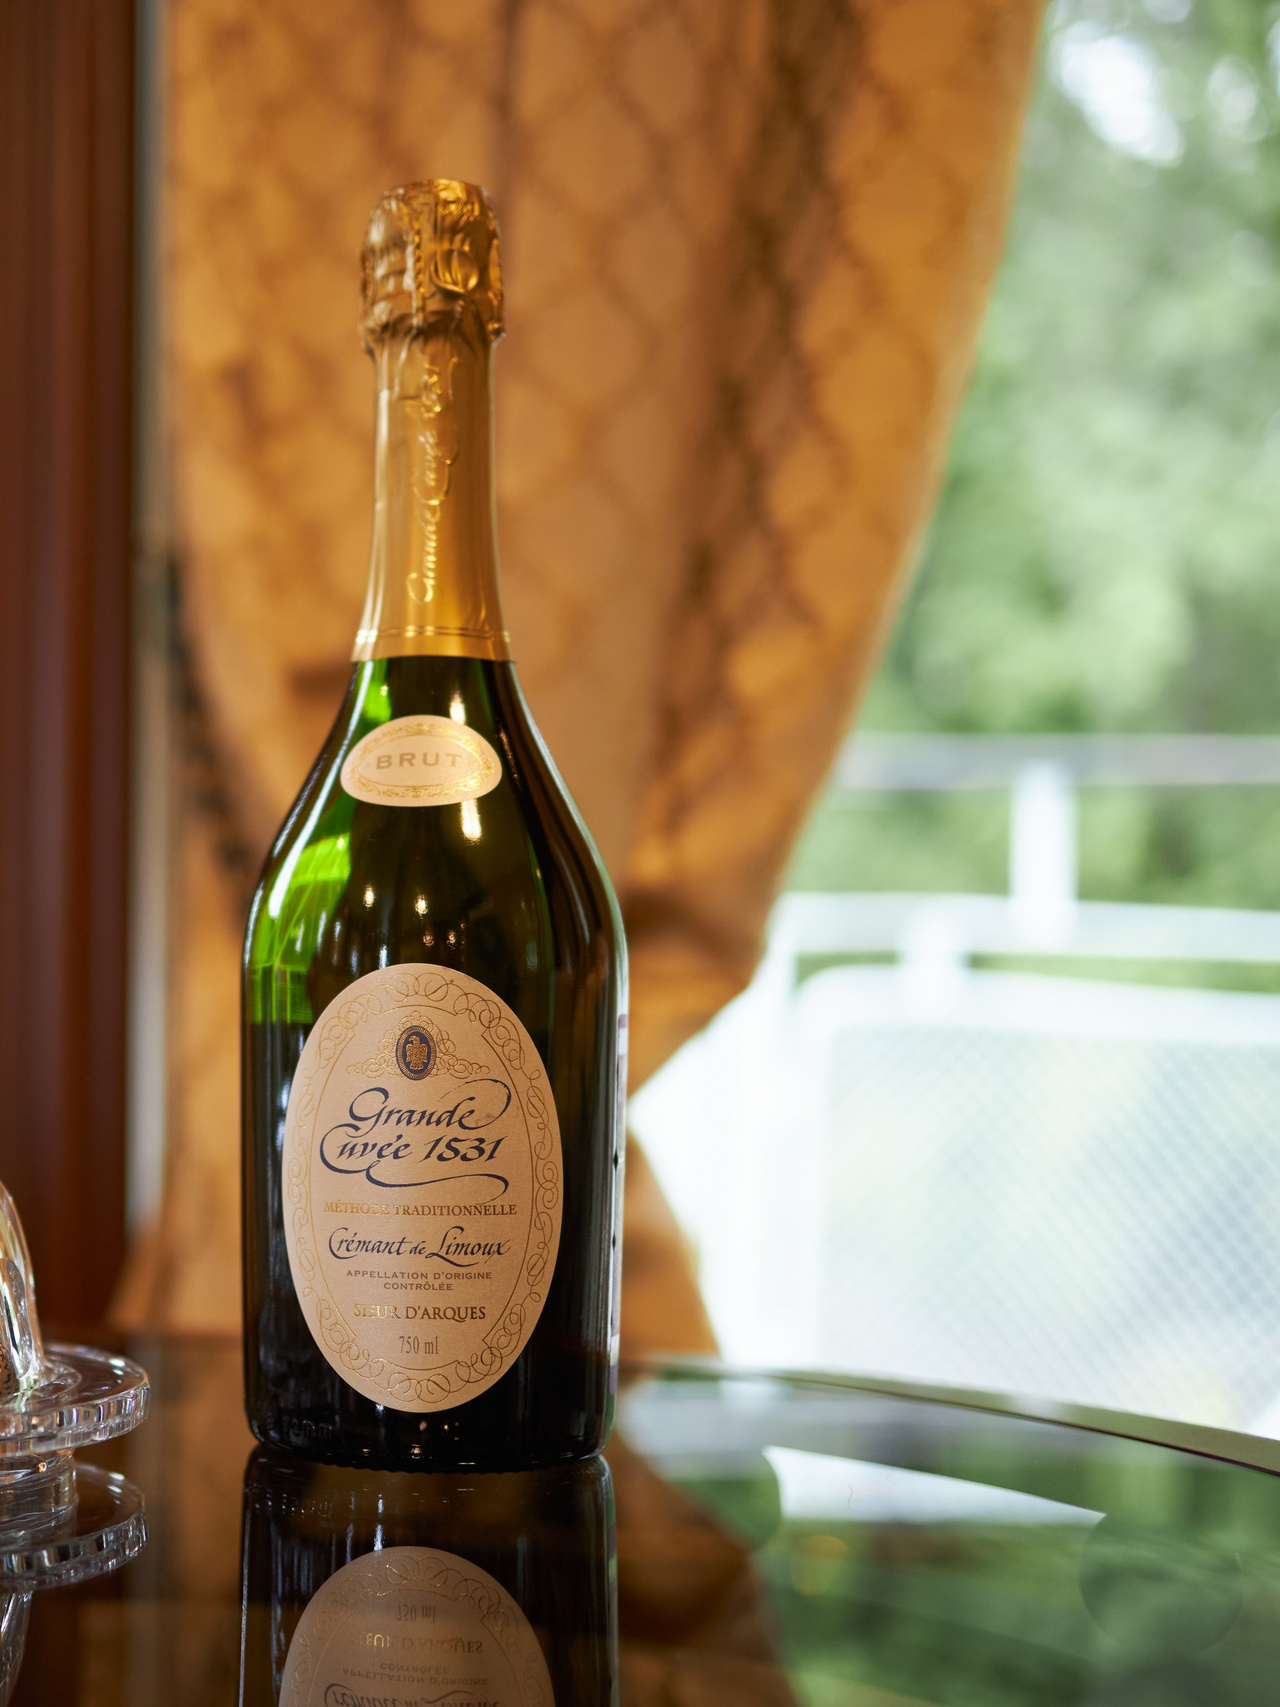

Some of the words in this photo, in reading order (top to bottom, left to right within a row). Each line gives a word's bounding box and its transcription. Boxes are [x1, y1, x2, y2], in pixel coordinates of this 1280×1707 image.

[375, 752, 462, 770] BRUT
[348, 1078, 512, 1138] Grande
[320, 1122, 414, 1174] Cuvée
[418, 1134, 509, 1164] 1531
[323, 1199, 391, 1217] MÉTHODE
[394, 1203, 519, 1217] TRADITIONNELLE
[328, 1226, 412, 1260] Crémant
[409, 1239, 426, 1255] de
[425, 1225, 512, 1268] Limoux
[345, 1269, 429, 1281] APPELLATION
[433, 1271, 493, 1281] D'ORIGINE
[383, 1280, 454, 1292] CONTRÔLÉE
[353, 1303, 399, 1320] SIEUR
[404, 1305, 487, 1323] D'ARQUES
[398, 1335, 421, 1355] 750
[424, 1335, 440, 1355] ml
